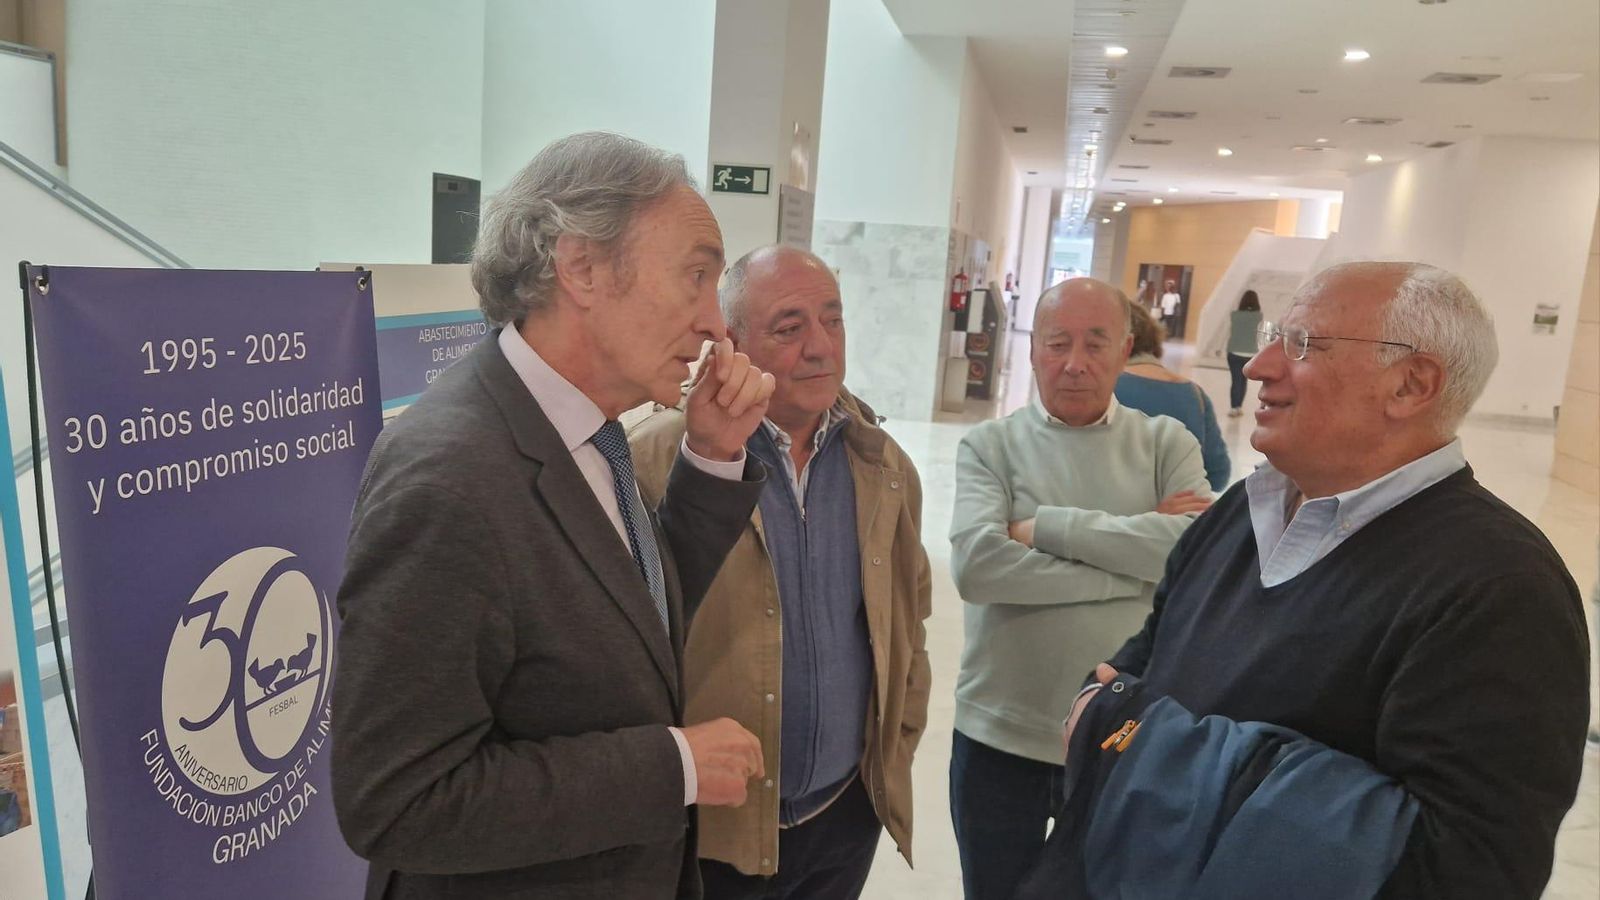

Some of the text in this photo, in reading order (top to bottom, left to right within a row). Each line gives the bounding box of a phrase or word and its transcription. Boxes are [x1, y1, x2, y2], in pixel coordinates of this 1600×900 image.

[140, 337, 217, 375] 1995
[244, 331, 307, 365] 2025
[419, 322, 486, 343] ABASTECIMIENTO
[432, 348, 444, 361] DE
[64, 377, 364, 453] 30 años de solidaridad
[87, 420, 356, 514] y compromiso social
[269, 696, 299, 717] FESBAL
[140, 728, 222, 827] FUNDACIÓN
[222, 783, 283, 827] BANCO
[284, 758, 307, 792] DE
[174, 743, 249, 792] ANIVERSARIO
[212, 781, 319, 865] GRANADA
